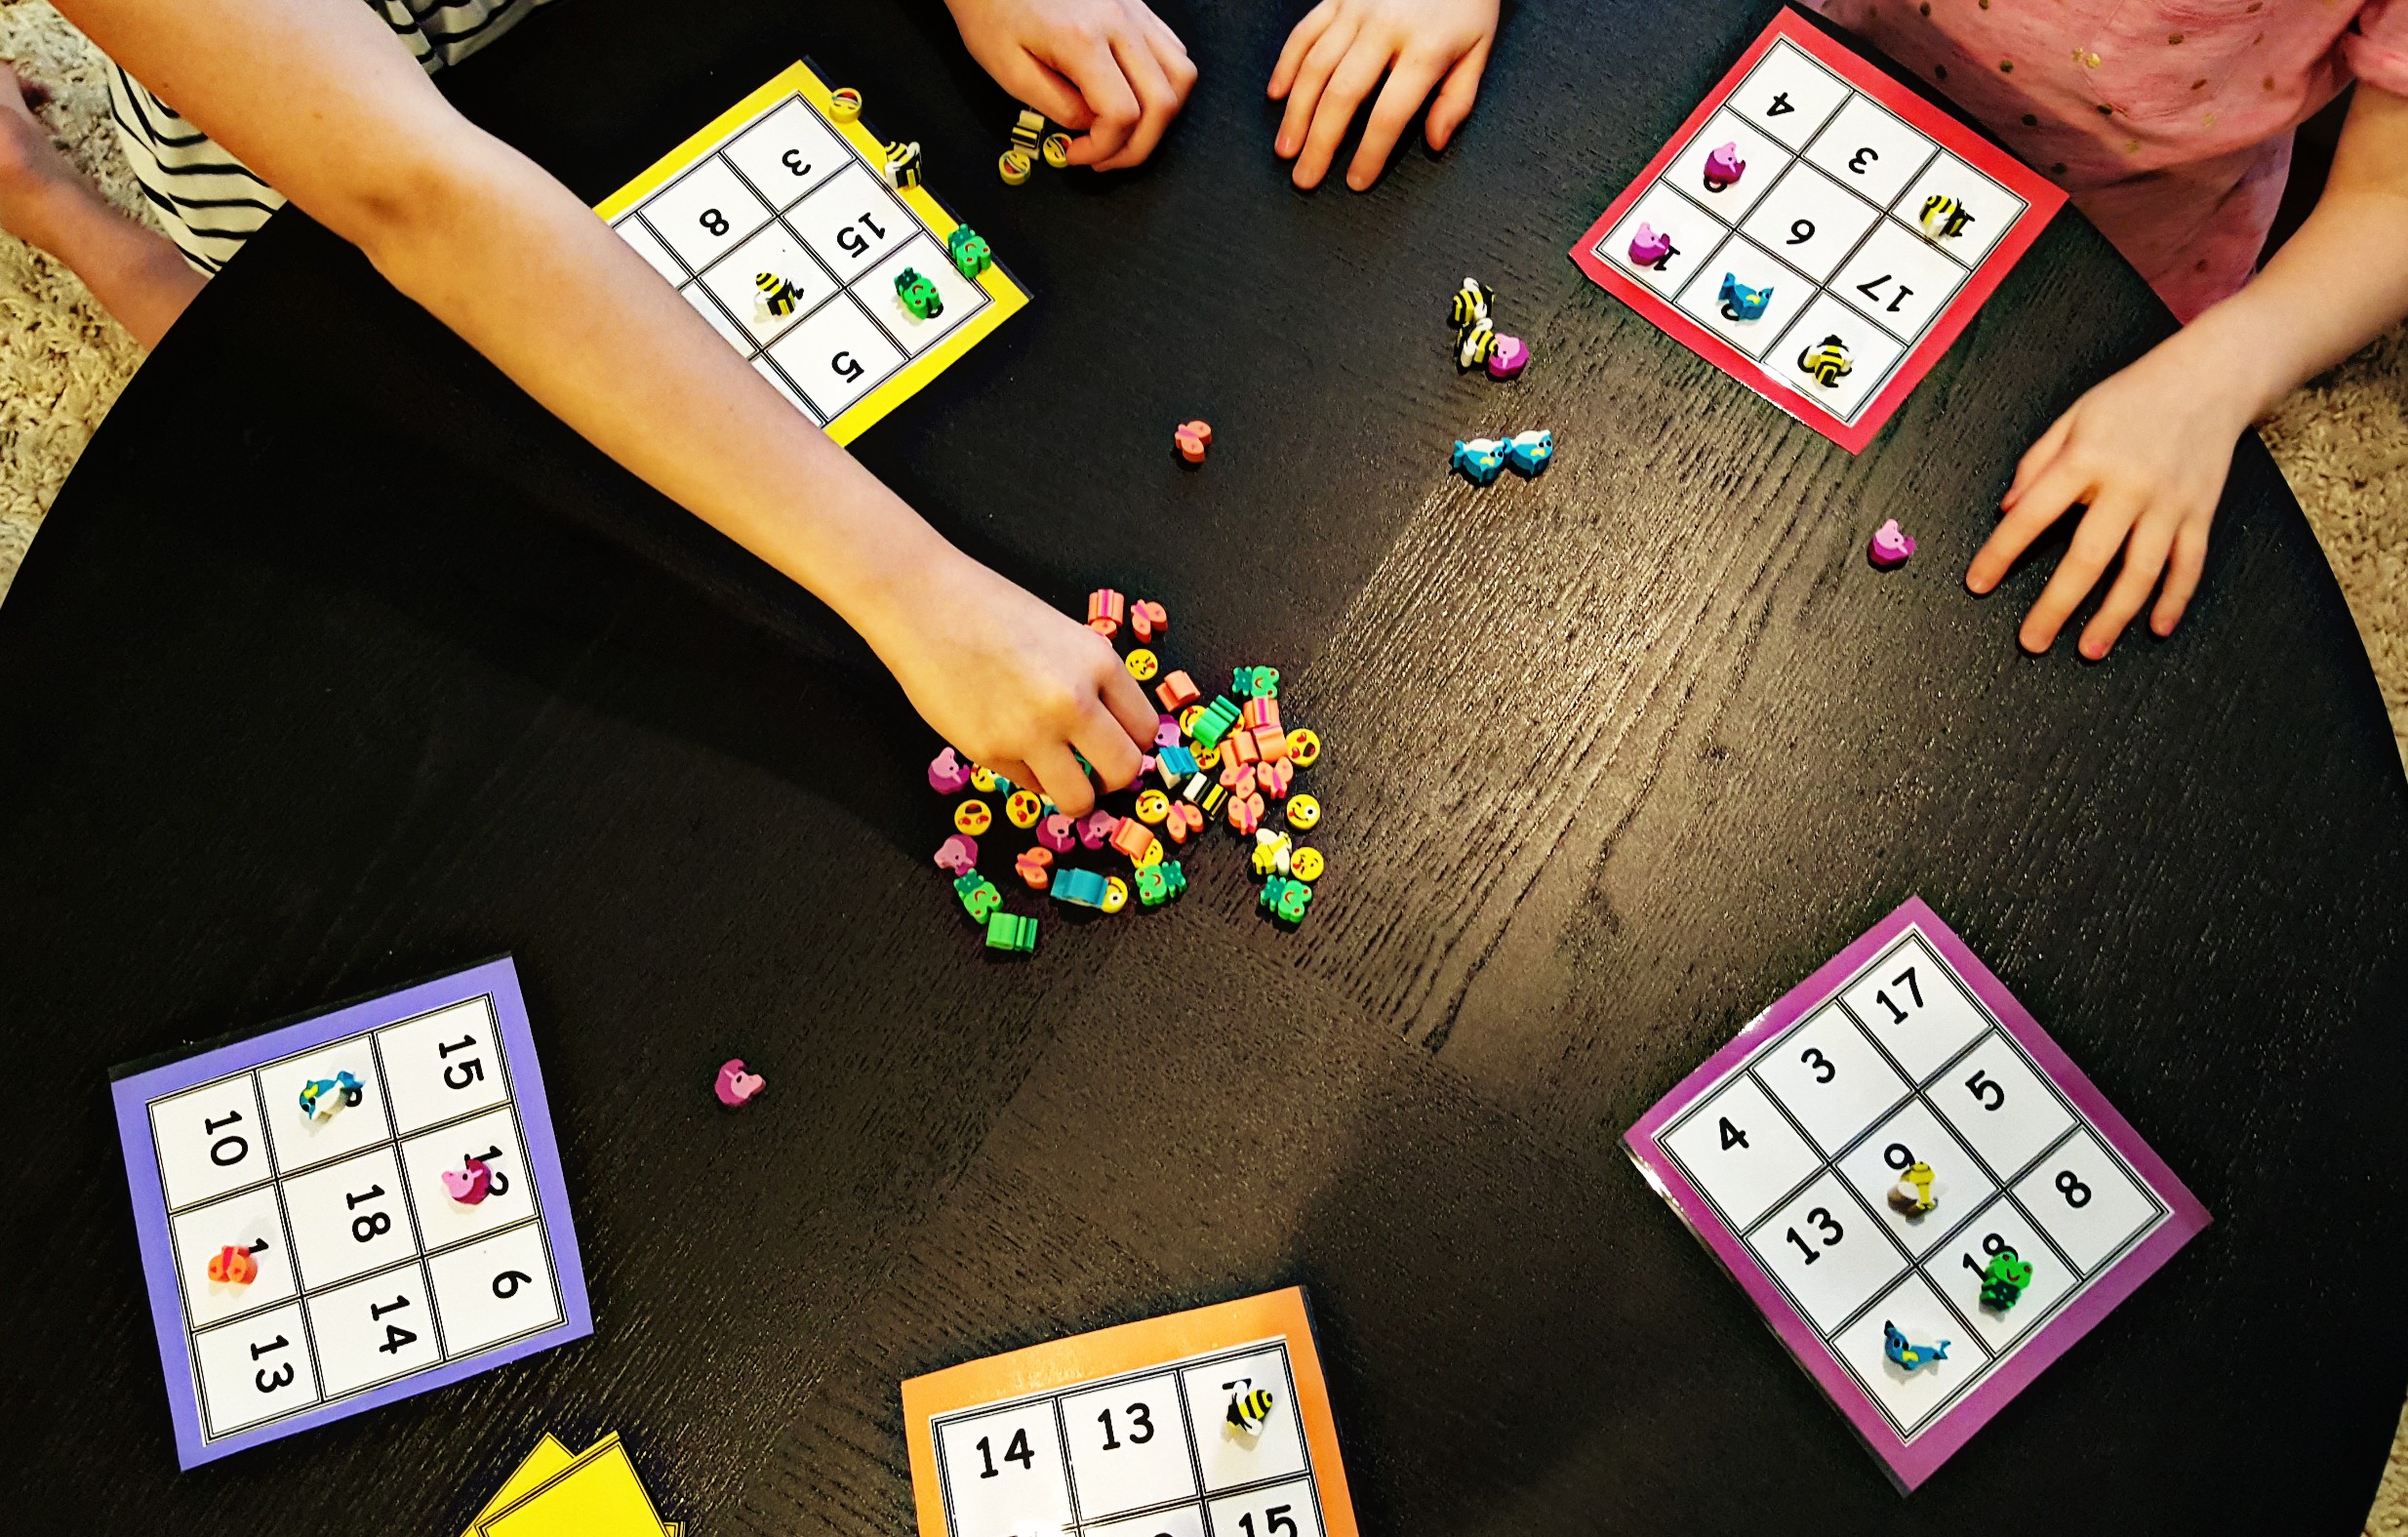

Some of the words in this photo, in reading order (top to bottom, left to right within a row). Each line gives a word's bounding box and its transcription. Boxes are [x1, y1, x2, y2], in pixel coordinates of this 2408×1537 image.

[1766, 92, 1795, 117] 4
[782, 148, 812, 177] 3
[1848, 146, 1879, 175] 3
[699, 208, 730, 237] 8
[836, 212, 886, 259] 15
[1786, 219, 1816, 245] 6
[1856, 274, 1914, 313] 17
[831, 350, 865, 384] 5
[1875, 966, 1924, 1025] 17
[438, 1034, 485, 1090] 15
[1800, 1047, 1836, 1084] 3
[1964, 1070, 2005, 1112] 5
[204, 1110, 249, 1167] 10
[1718, 1116, 1750, 1152] 4
[2055, 1170, 2092, 1209] 8
[345, 1184, 391, 1243] 18
[1786, 1206, 1844, 1266] 13
[492, 1270, 533, 1299] 6
[370, 1295, 418, 1355] 14
[250, 1334, 295, 1394] 13
[1097, 1402, 1155, 1451] 13
[976, 1428, 1035, 1479] 14
[1238, 1504, 1299, 1537] 15
